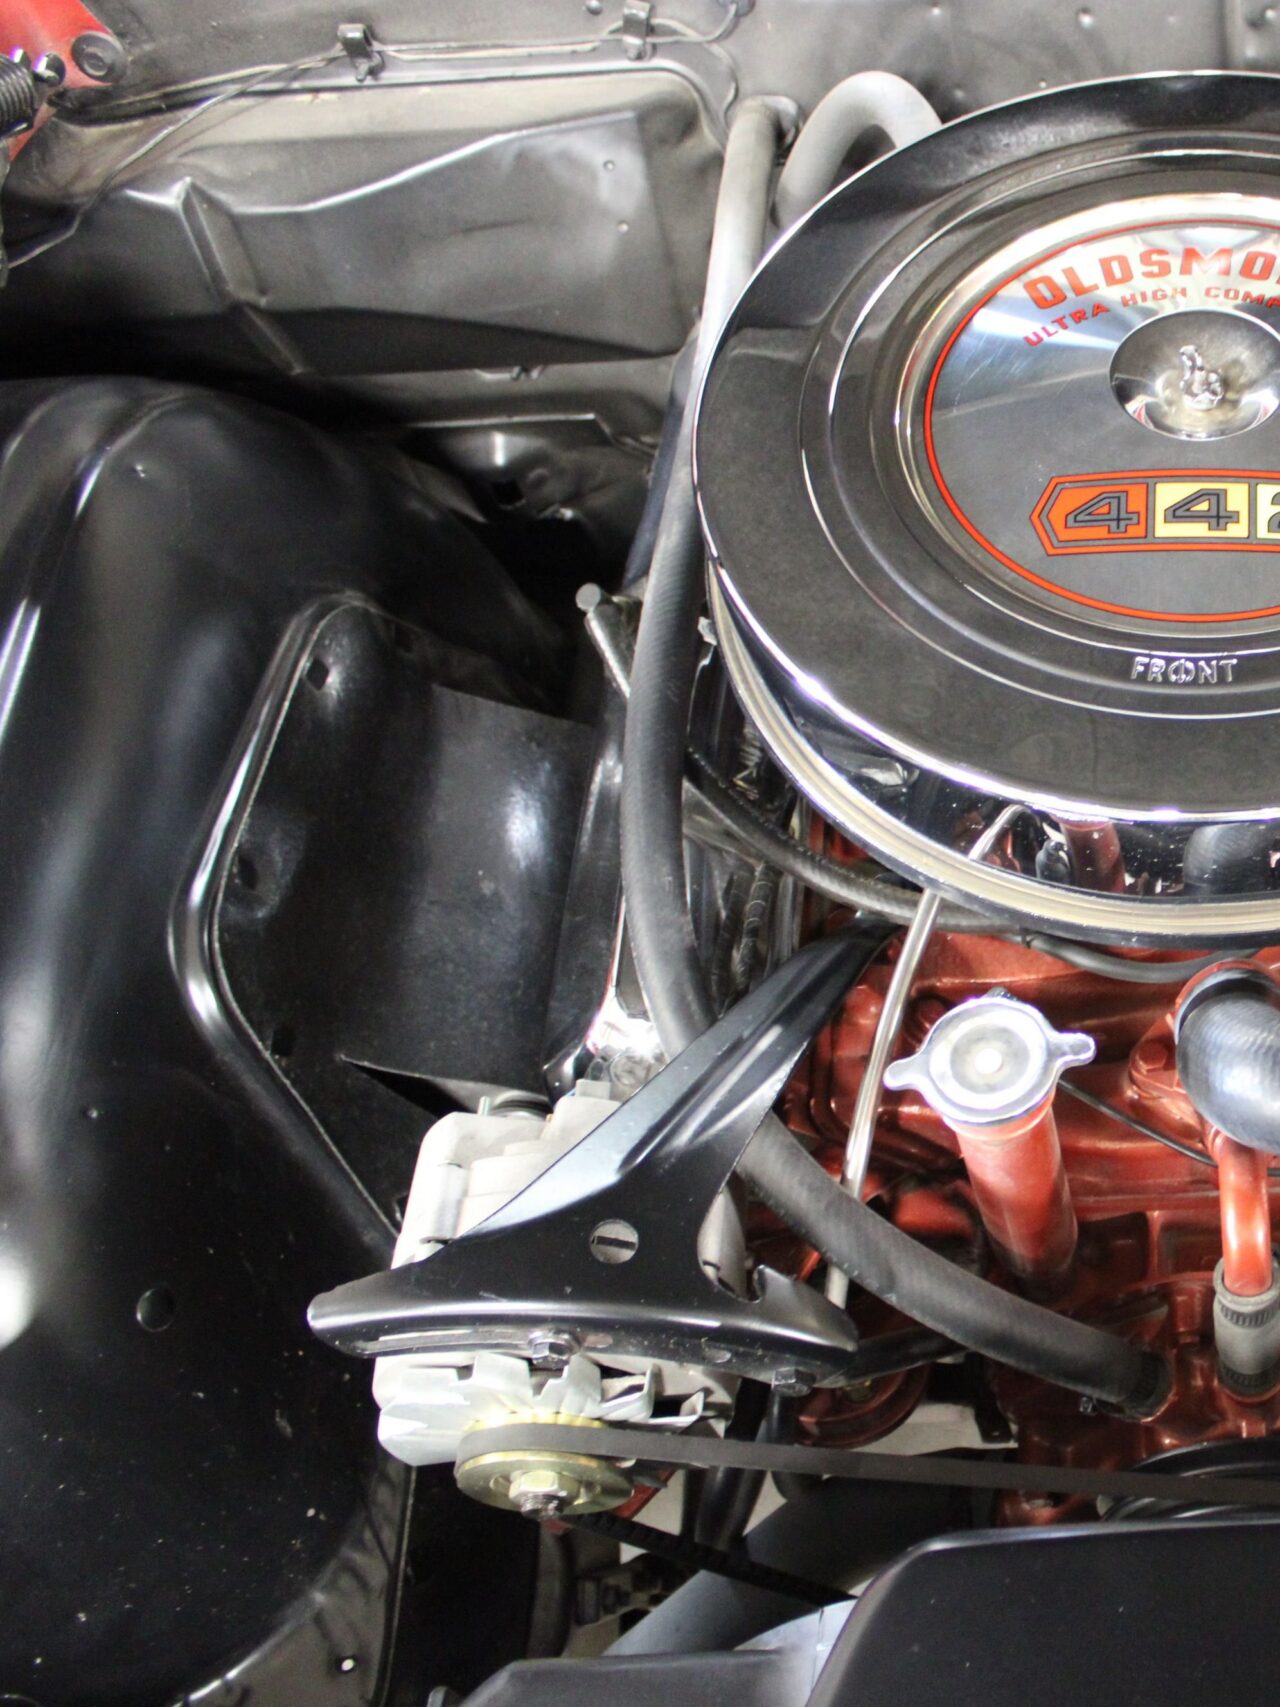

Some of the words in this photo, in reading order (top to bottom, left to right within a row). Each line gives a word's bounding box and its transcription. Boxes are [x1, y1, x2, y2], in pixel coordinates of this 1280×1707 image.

[1024, 301, 1109, 346] ULTRA
[1121, 287, 1189, 306] HIGH
[1131, 656, 1238, 685] FRONT
